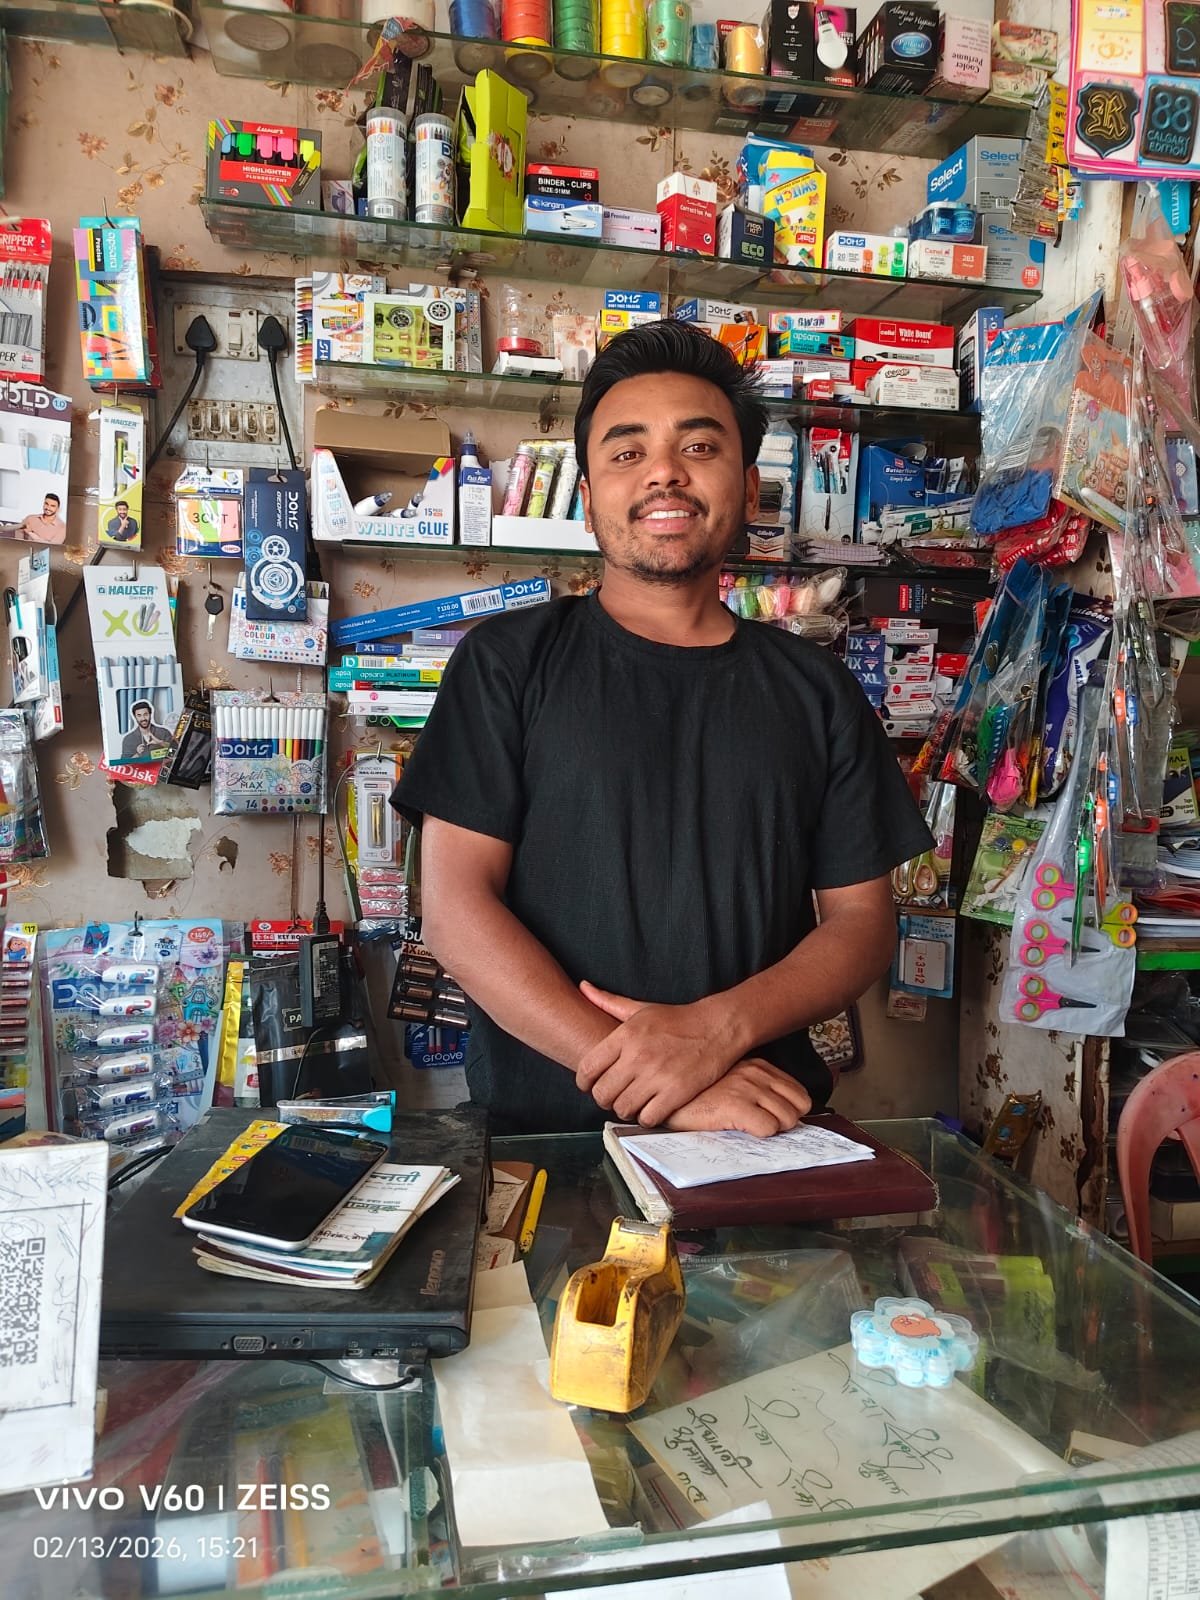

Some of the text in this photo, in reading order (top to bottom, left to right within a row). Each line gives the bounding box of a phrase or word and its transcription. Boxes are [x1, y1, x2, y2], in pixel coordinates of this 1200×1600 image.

[1152, 91, 1193, 133] 88
[1147, 130, 1191, 147] CALGARY
[1149, 141, 1187, 156] EDITION
[980, 150, 1020, 161] Select
[242, 165, 292, 177] HIGHLIGHTER
[930, 157, 964, 192] Select
[245, 173, 288, 184] FLUORESCENT
[537, 177, 564, 188] BINDER
[570, 181, 593, 191] CLIPS
[774, 179, 818, 206] SWITCH
[680, 203, 703, 216] Correction
[838, 236, 865, 247] DOMS
[95, 237, 103, 262] Precise
[108, 232, 119, 269] apsara
[741, 241, 765, 258] ECO
[1024, 269, 1037, 278] FREE
[607, 294, 641, 304] DOMS
[676, 304, 693, 320] DOMS
[708, 303, 732, 316] DOMS
[792, 330, 820, 342] apsara
[899, 327, 932, 341] White Board
[110, 417, 137, 428] HAUSER
[288, 490, 299, 531] DOMS
[423, 507, 433, 517] 15
[353, 519, 449, 538] WHITE GLUE
[1066, 534, 1076, 544] 70
[107, 584, 154, 596] HAUSER
[504, 579, 542, 598] DOMS
[247, 622, 273, 633] WATER
[243, 630, 276, 641] COLOUR
[242, 646, 254, 656] 24
[359, 671, 385, 680] apsara
[862, 672, 882, 685] XL
[220, 743, 272, 756] DOMS
[226, 769, 265, 787] Sketch
[240, 780, 263, 790] MAX
[245, 799, 258, 809] 14
[402, 943, 417, 955] 2X
[420, 1249, 446, 1296] lenovo
